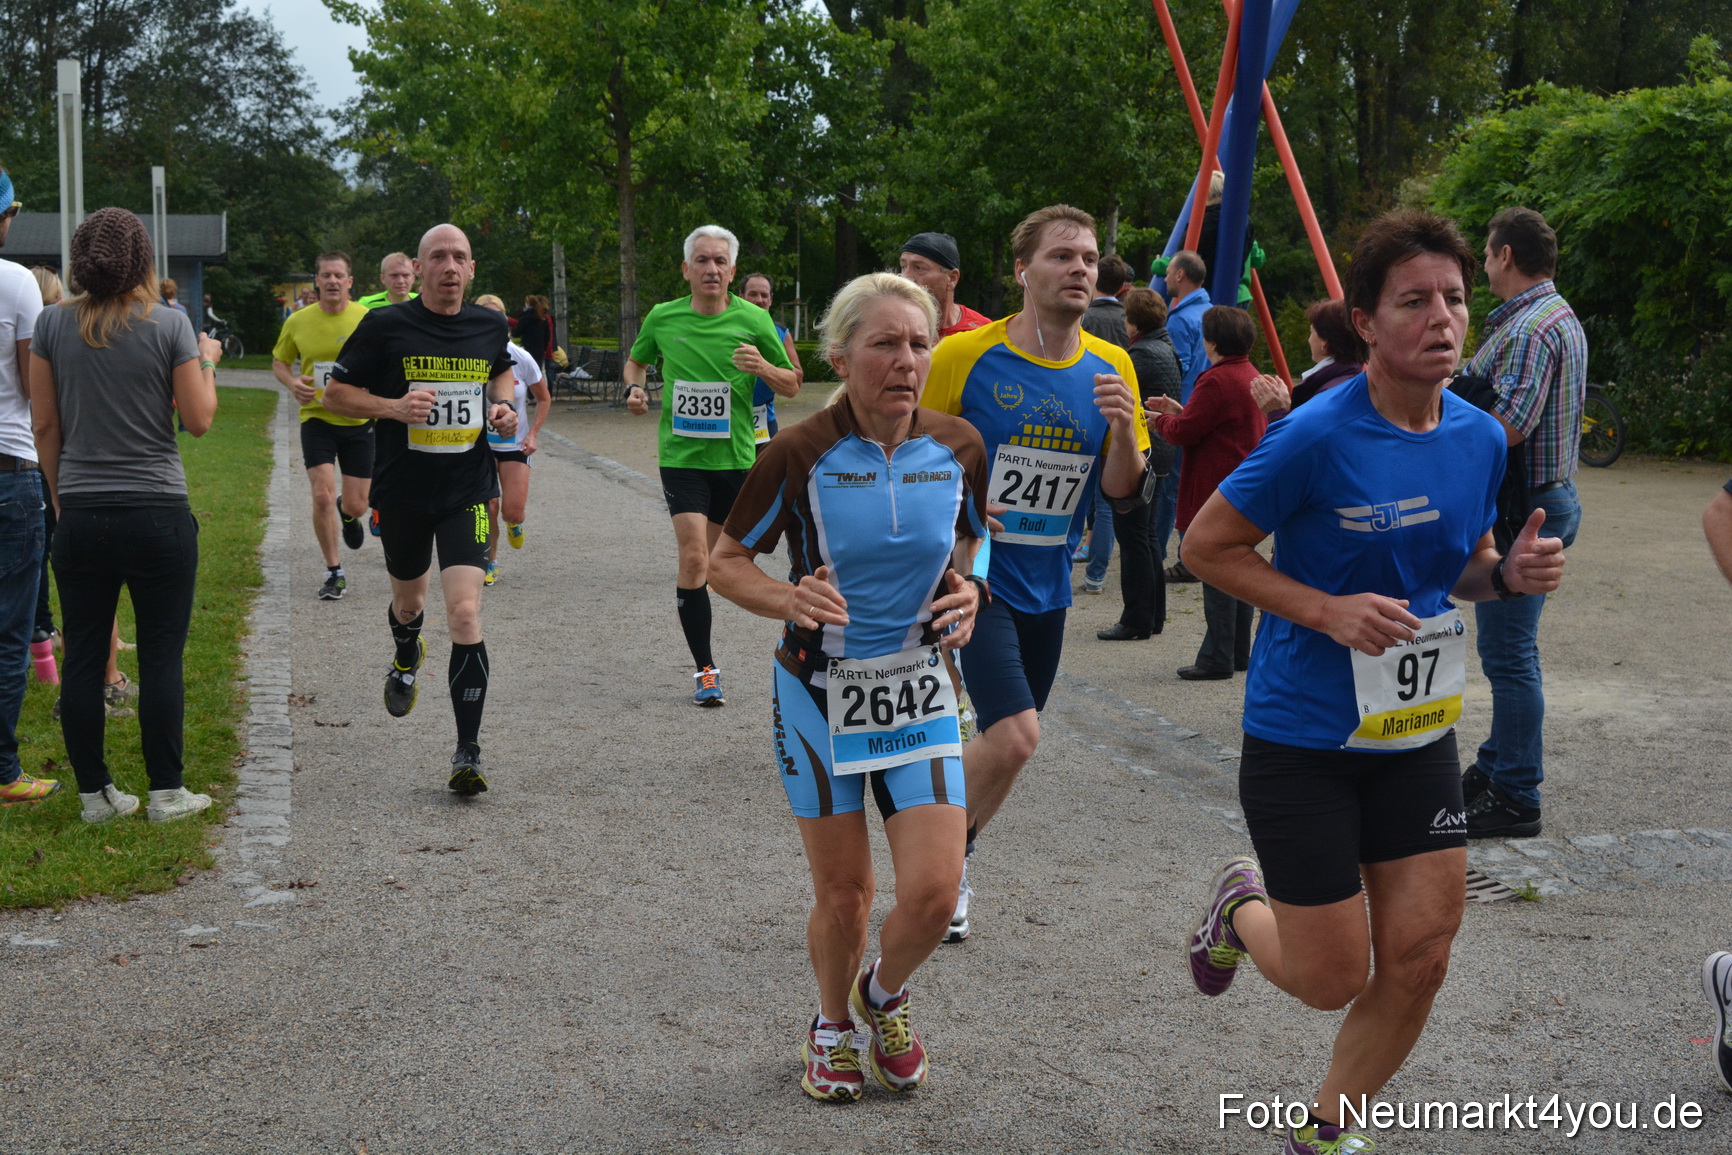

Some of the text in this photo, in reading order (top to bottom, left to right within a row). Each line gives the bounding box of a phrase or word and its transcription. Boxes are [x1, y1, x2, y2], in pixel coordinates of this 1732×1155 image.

[406, 370, 461, 380] TEAM MEMBER
[437, 387, 472, 396] Neumarkt
[674, 384, 690, 393] PARTL
[678, 394, 725, 417] 2339
[682, 420, 717, 430] Christian
[998, 452, 1078, 473] PARTL Neumarkt
[998, 469, 1081, 511] 2417
[1018, 517, 1047, 532] Rudi
[1406, 627, 1452, 647] Neumarkt
[829, 659, 925, 680] PARTL Neumarkt
[1397, 647, 1440, 701] 97
[841, 674, 945, 727] 2642
[1381, 708, 1445, 736] Marianne
[868, 730, 927, 755] Marion
